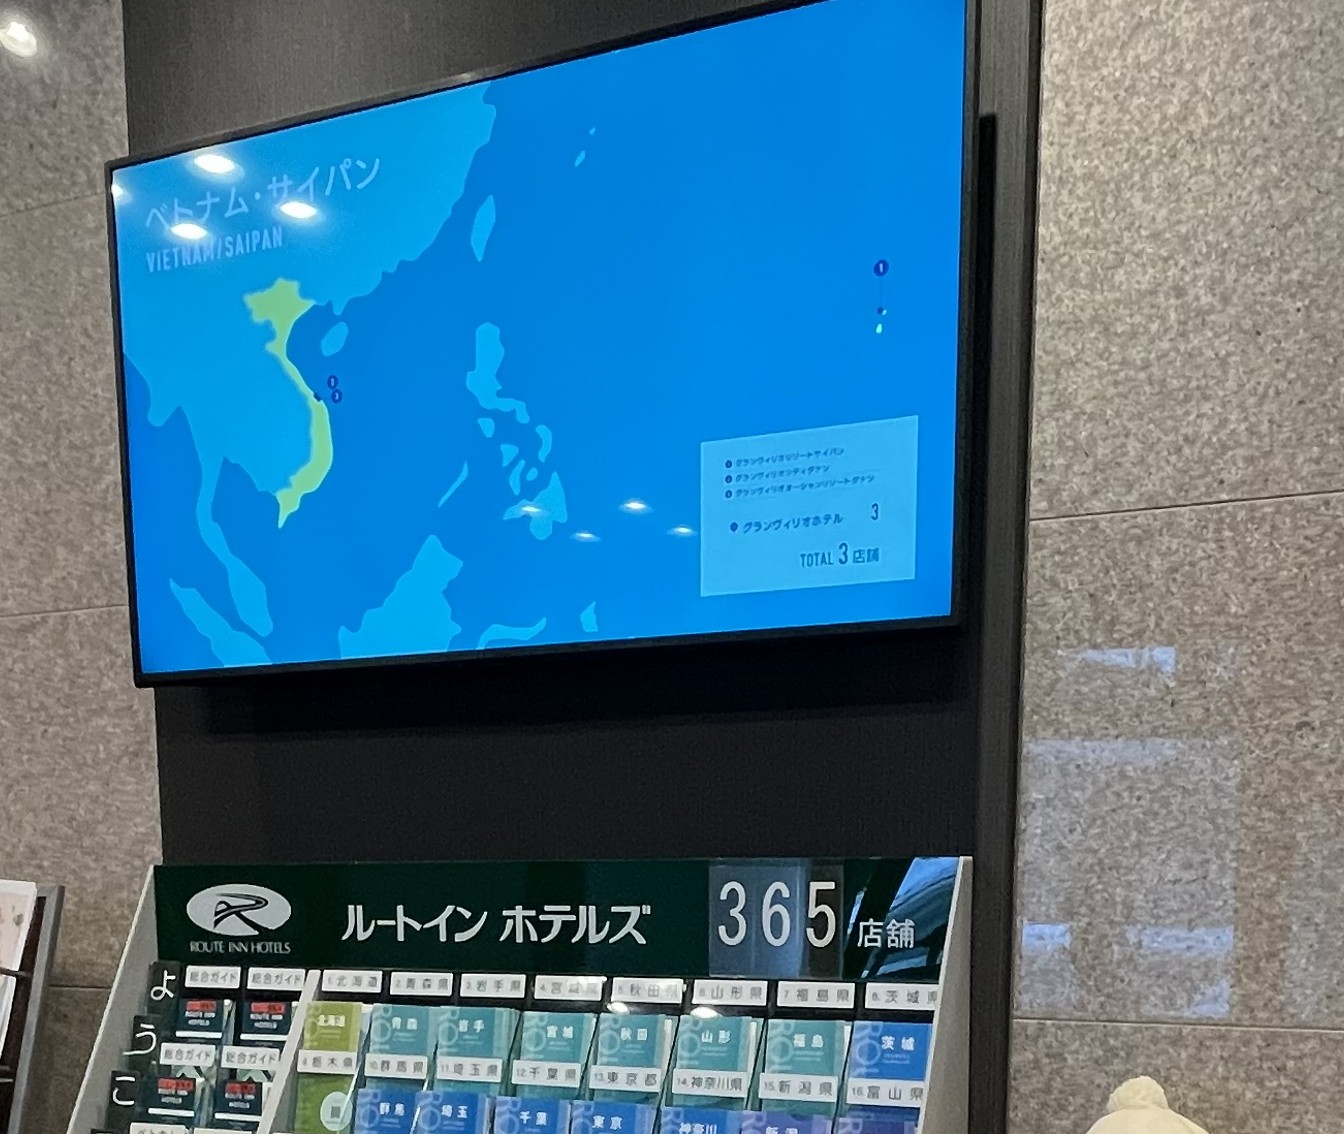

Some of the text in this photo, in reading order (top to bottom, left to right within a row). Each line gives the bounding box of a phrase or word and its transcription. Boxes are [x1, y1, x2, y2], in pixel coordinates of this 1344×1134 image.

[145, 158, 380, 229] ベトナム・サイパン
[146, 226, 283, 273] VIETNAM/SAIPAN
[742, 502, 879, 534] グランヴィリオホテル 3
[800, 542, 880, 568] TOTAL 3 店舗
[341, 881, 916, 949] ルートイン ホテルズ 365 店舗
[189, 941, 291, 955] ROUTE INN HOTELS
[701, 1029, 731, 1044] 山形
